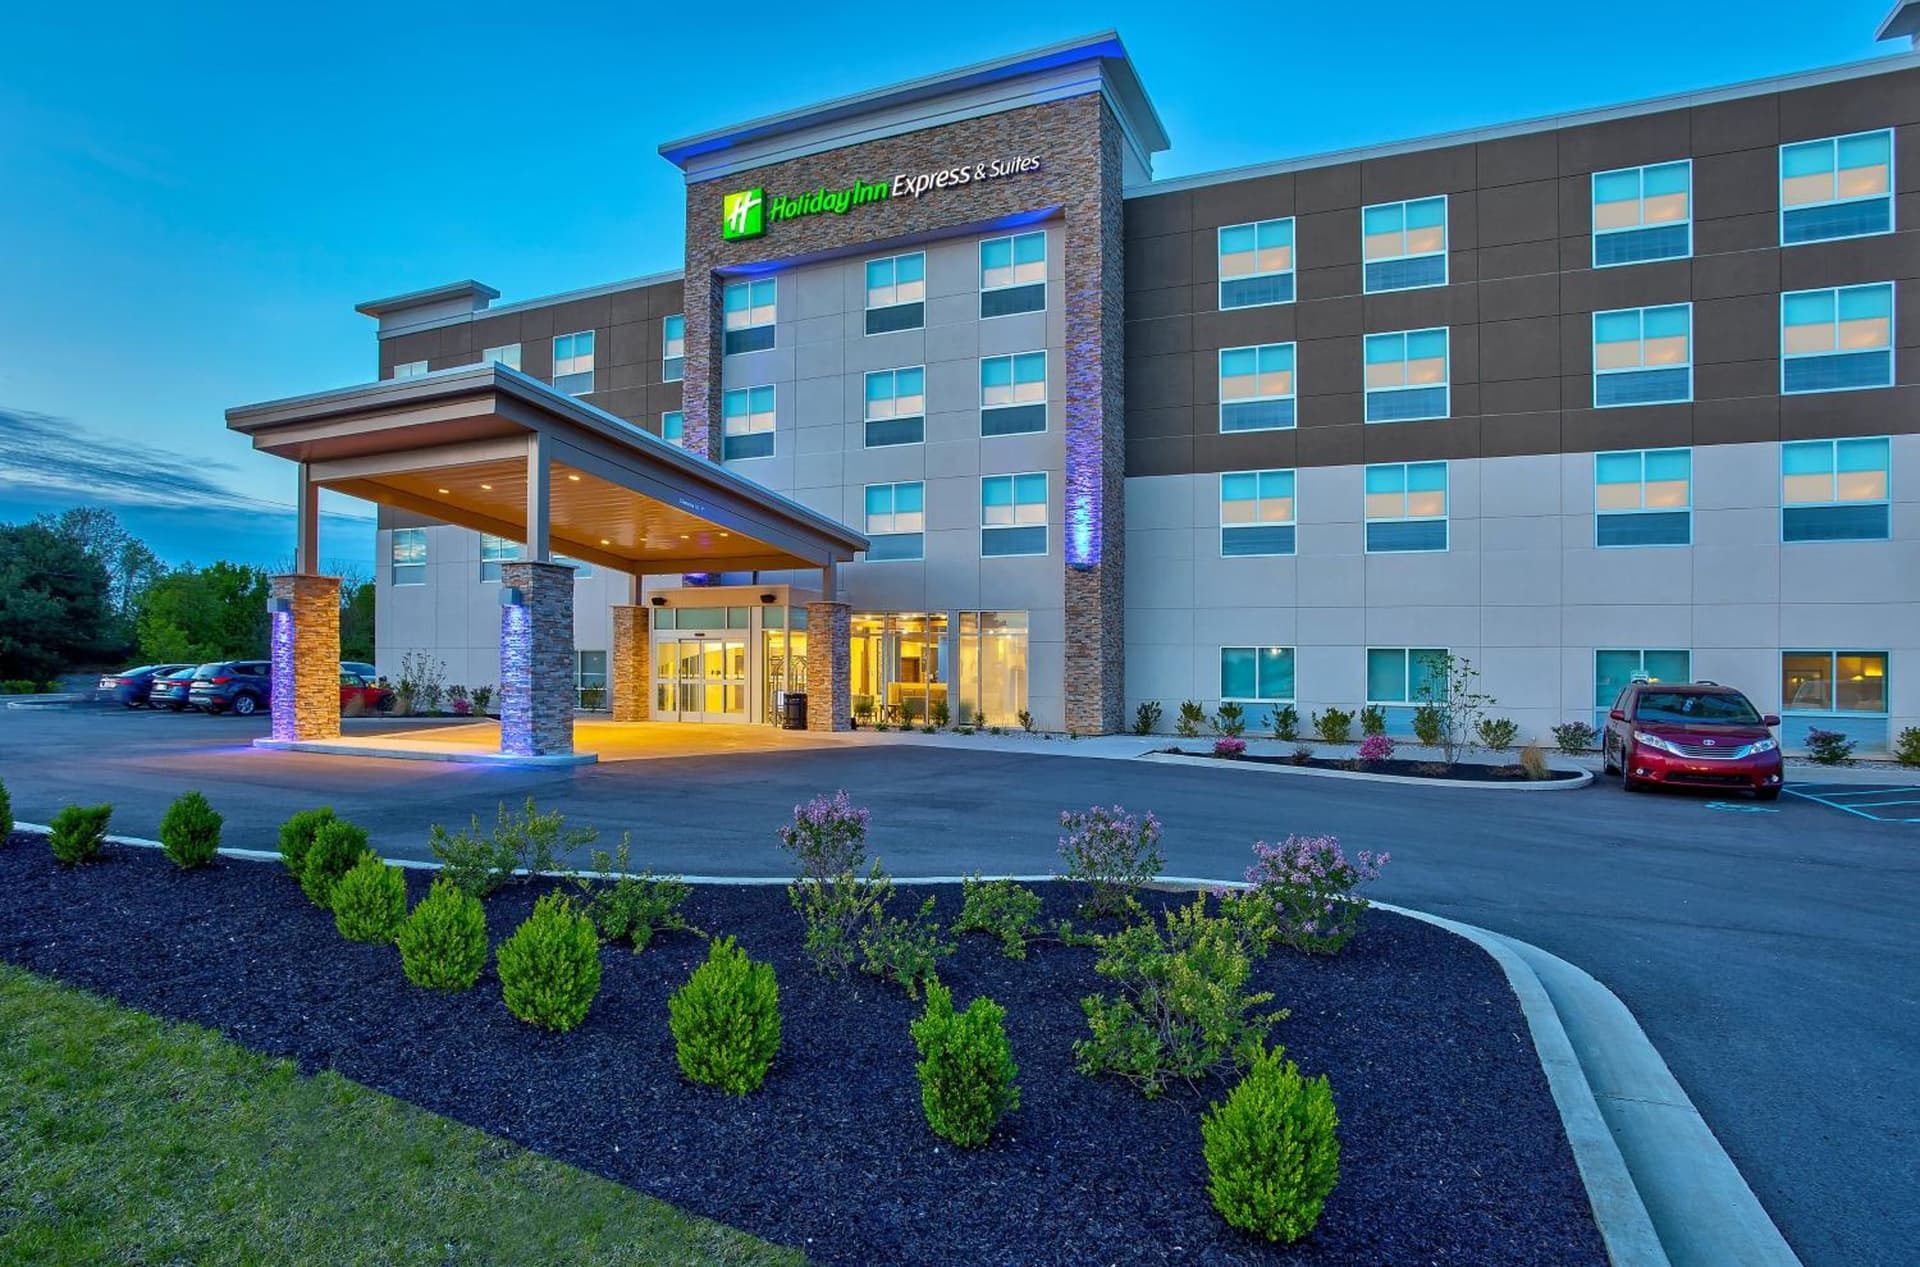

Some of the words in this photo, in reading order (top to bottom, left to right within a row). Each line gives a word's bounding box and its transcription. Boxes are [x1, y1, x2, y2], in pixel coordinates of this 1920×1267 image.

[770, 187, 851, 221] Holiday
[853, 177, 889, 205] Inn
[892, 165, 971, 198] Express
[974, 162, 986, 180] &
[990, 155, 1041, 178] Suites
